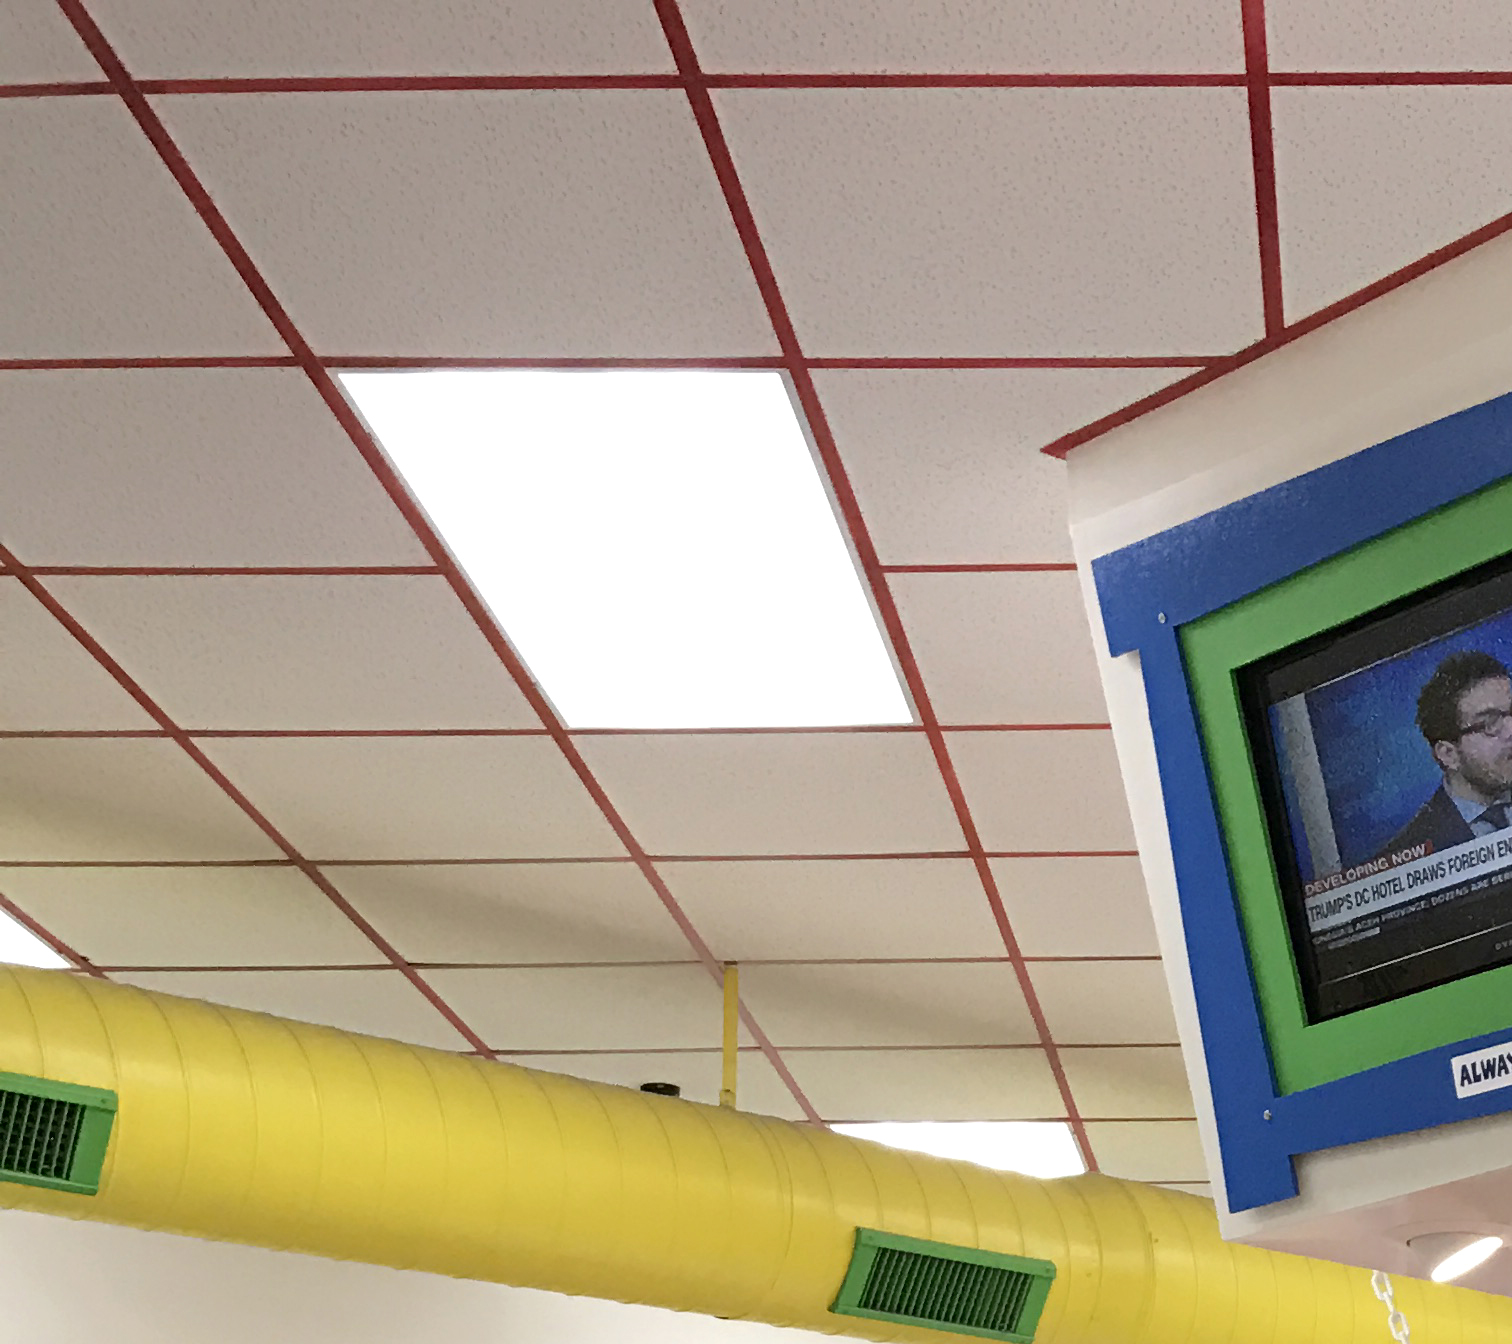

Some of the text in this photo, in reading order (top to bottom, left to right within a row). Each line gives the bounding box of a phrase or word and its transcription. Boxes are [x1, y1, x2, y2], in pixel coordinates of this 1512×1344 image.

[1305, 842, 1427, 896] DEVELOPING NOW
[1308, 890, 1354, 923] TRUMP'S
[1354, 887, 1371, 908] DC
[1372, 879, 1405, 903] HOTEL
[1406, 864, 1447, 889] DRAWS
[1447, 847, 1495, 876] FOREIGN
